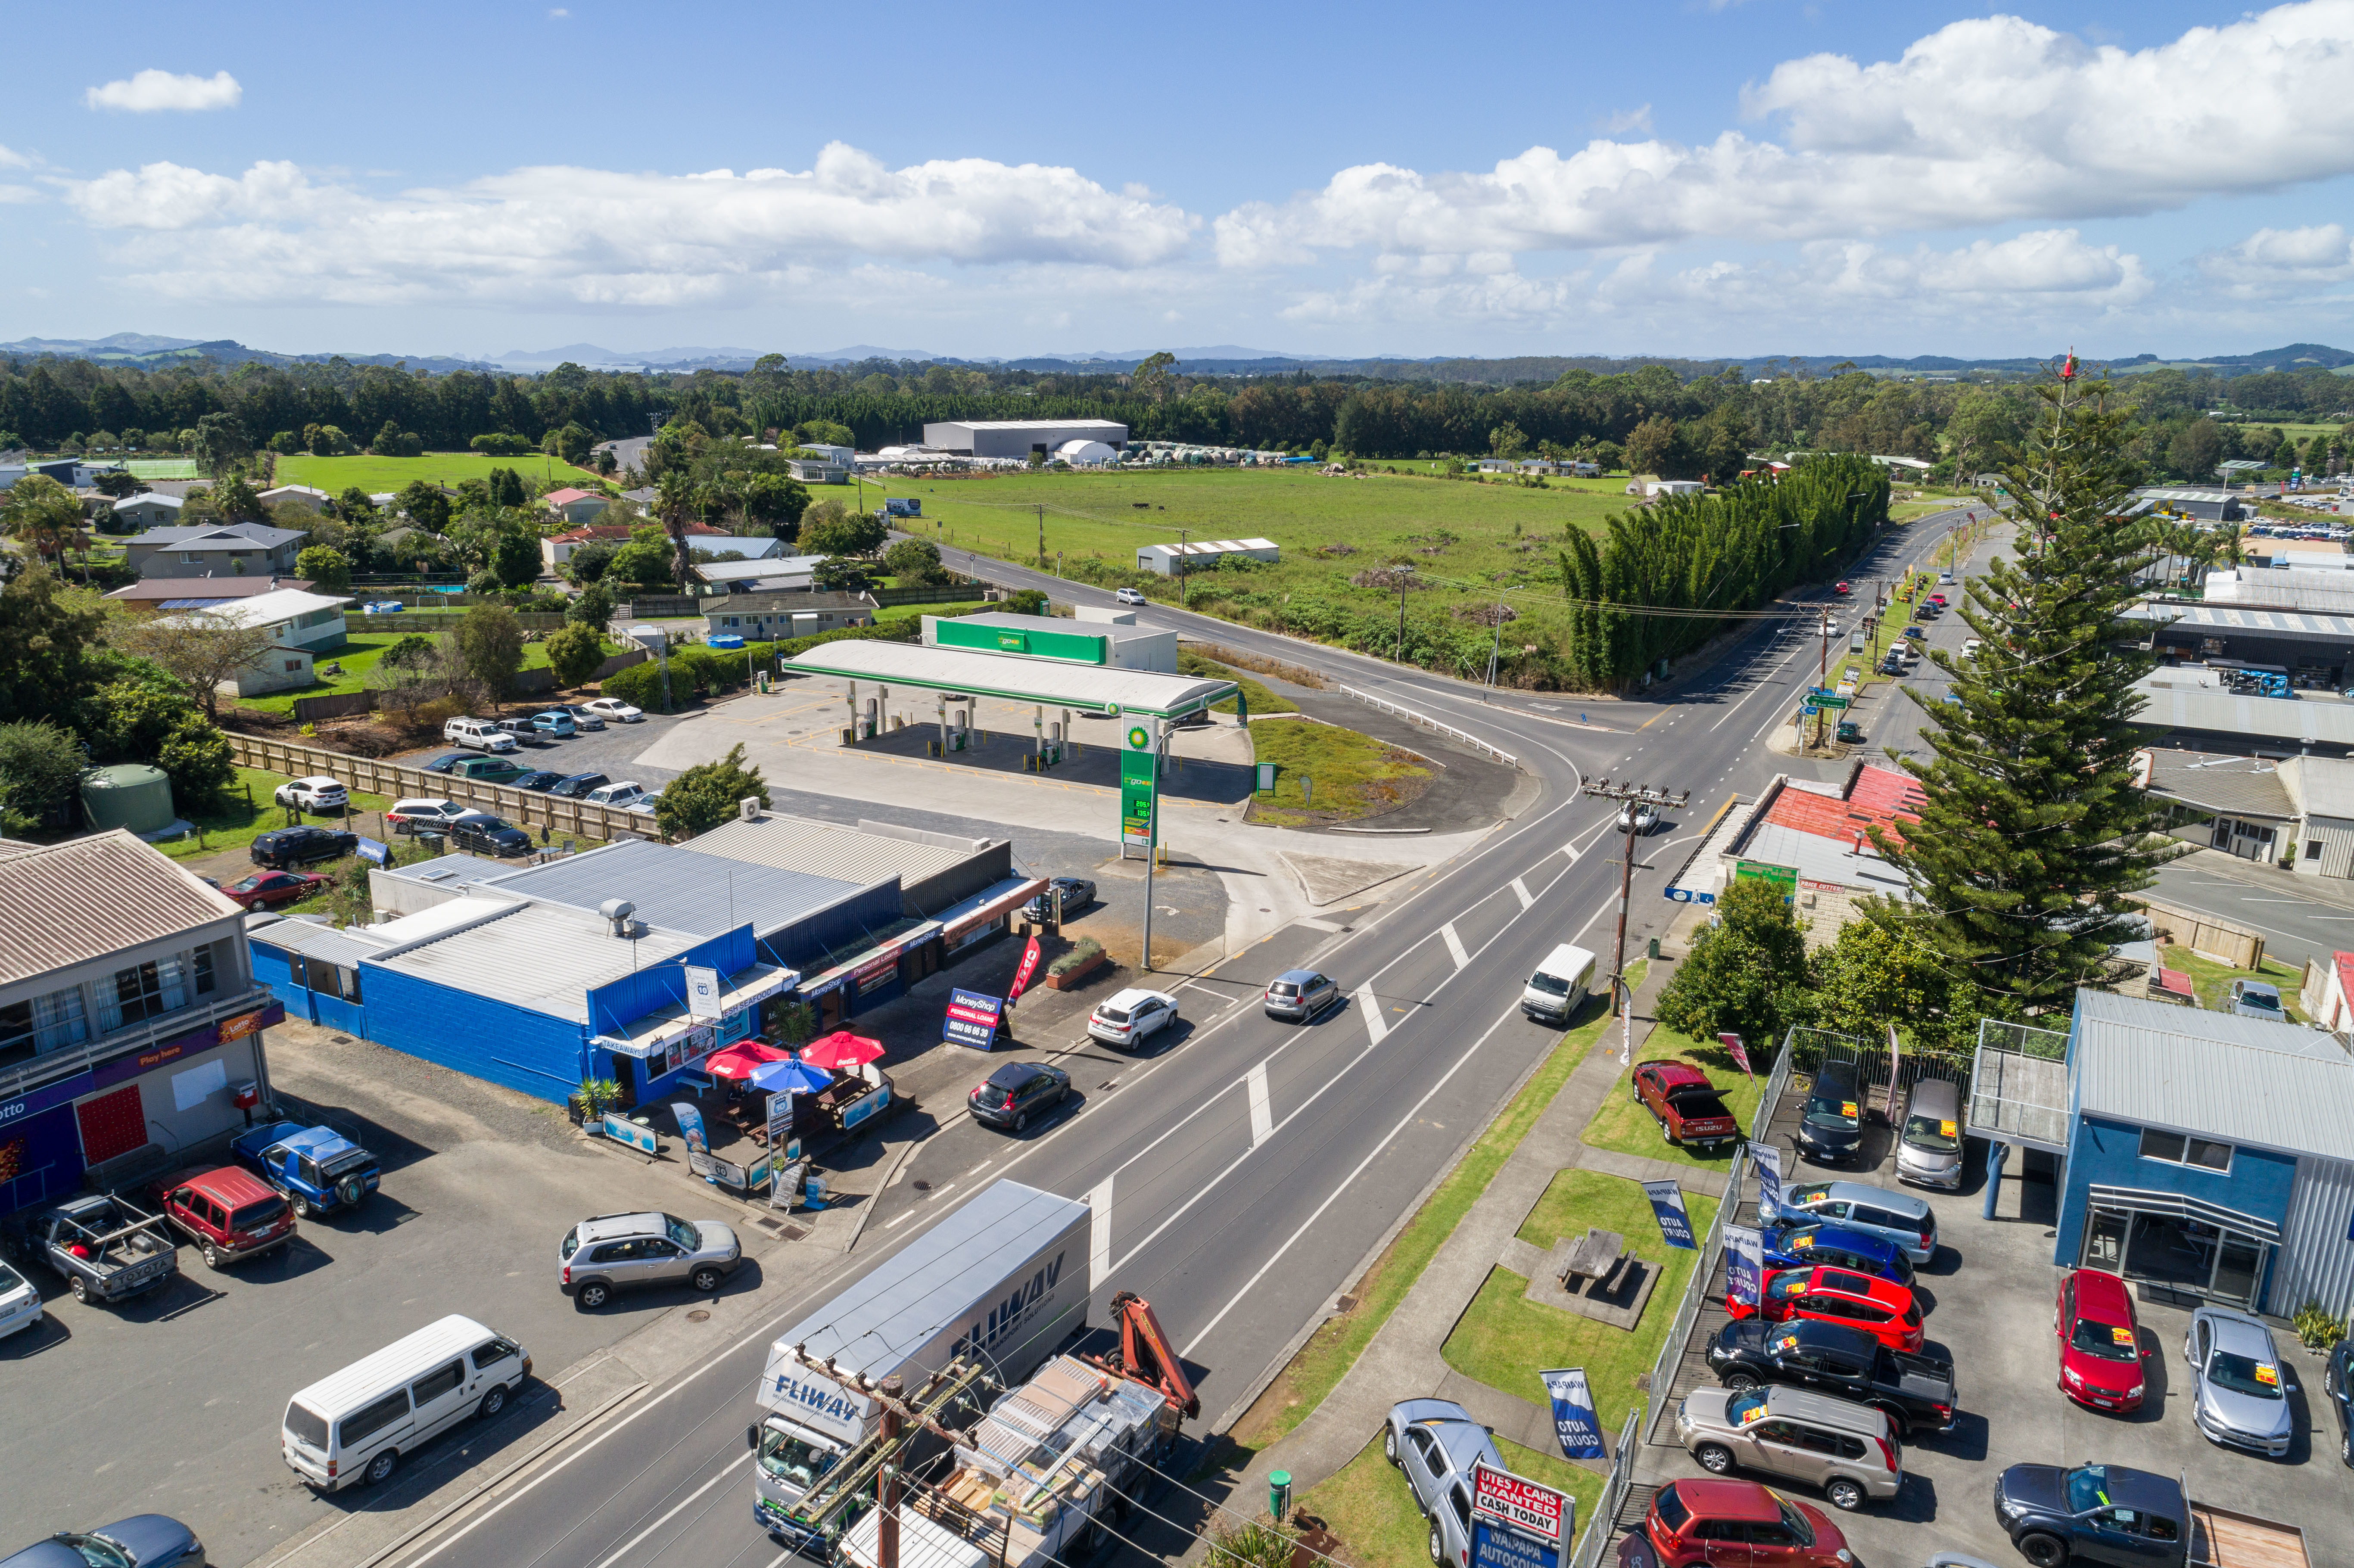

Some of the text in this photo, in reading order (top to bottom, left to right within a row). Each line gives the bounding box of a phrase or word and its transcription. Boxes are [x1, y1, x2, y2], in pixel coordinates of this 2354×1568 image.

[360, 844, 383, 859] MoneyShop
[1818, 884, 1844, 892] CUTTER!
[909, 930, 935, 948] MoneyShop
[854, 949, 899, 976] Personal Loans
[860, 963, 894, 984] Personal Loans
[811, 978, 841, 998] MoneyShop
[739, 989, 772, 1008] SEAFOOD
[955, 995, 995, 1012] MoneyShop
[950, 1008, 994, 1023] PERSONAL LOANS
[229, 1018, 250, 1033] Lotto
[950, 1021, 989, 1038] 0800 66 66 39
[691, 1029, 711, 1042] SALE
[947, 1032, 987, 1045] www.moneyshop.co.nz
[140, 1047, 180, 1065] Play here
[603, 1039, 642, 1057] TAKEAWAYS
[651, 1043, 663, 1055] 10
[770, 1089, 791, 1101] SEAFOOD
[771, 1108, 792, 1119] TAKEAWAYS
[775, 1103, 786, 1112] 10
[716, 1167, 727, 1176] 10
[118, 1260, 167, 1284] TOYOTA
[950, 1250, 1065, 1361] FLIWAY
[987, 1293, 1055, 1354] TRANSPORT SOLUTIONS
[1140, 1313, 1155, 1337] PALFINGER
[775, 1373, 861, 1422] FLIWAY
[772, 1393, 848, 1428] DELIVERING TRANSPORT SOLUTIONS
[1481, 1470, 1512, 1490] UTES
[1523, 1486, 1557, 1506] CARS
[1480, 1481, 1557, 1516] WANTED
[1481, 1495, 1552, 1530] CASH TODAY
[1490, 1528, 1541, 1561] WAIPAPA
[1479, 1543, 1547, 1568] AUTOCOU
